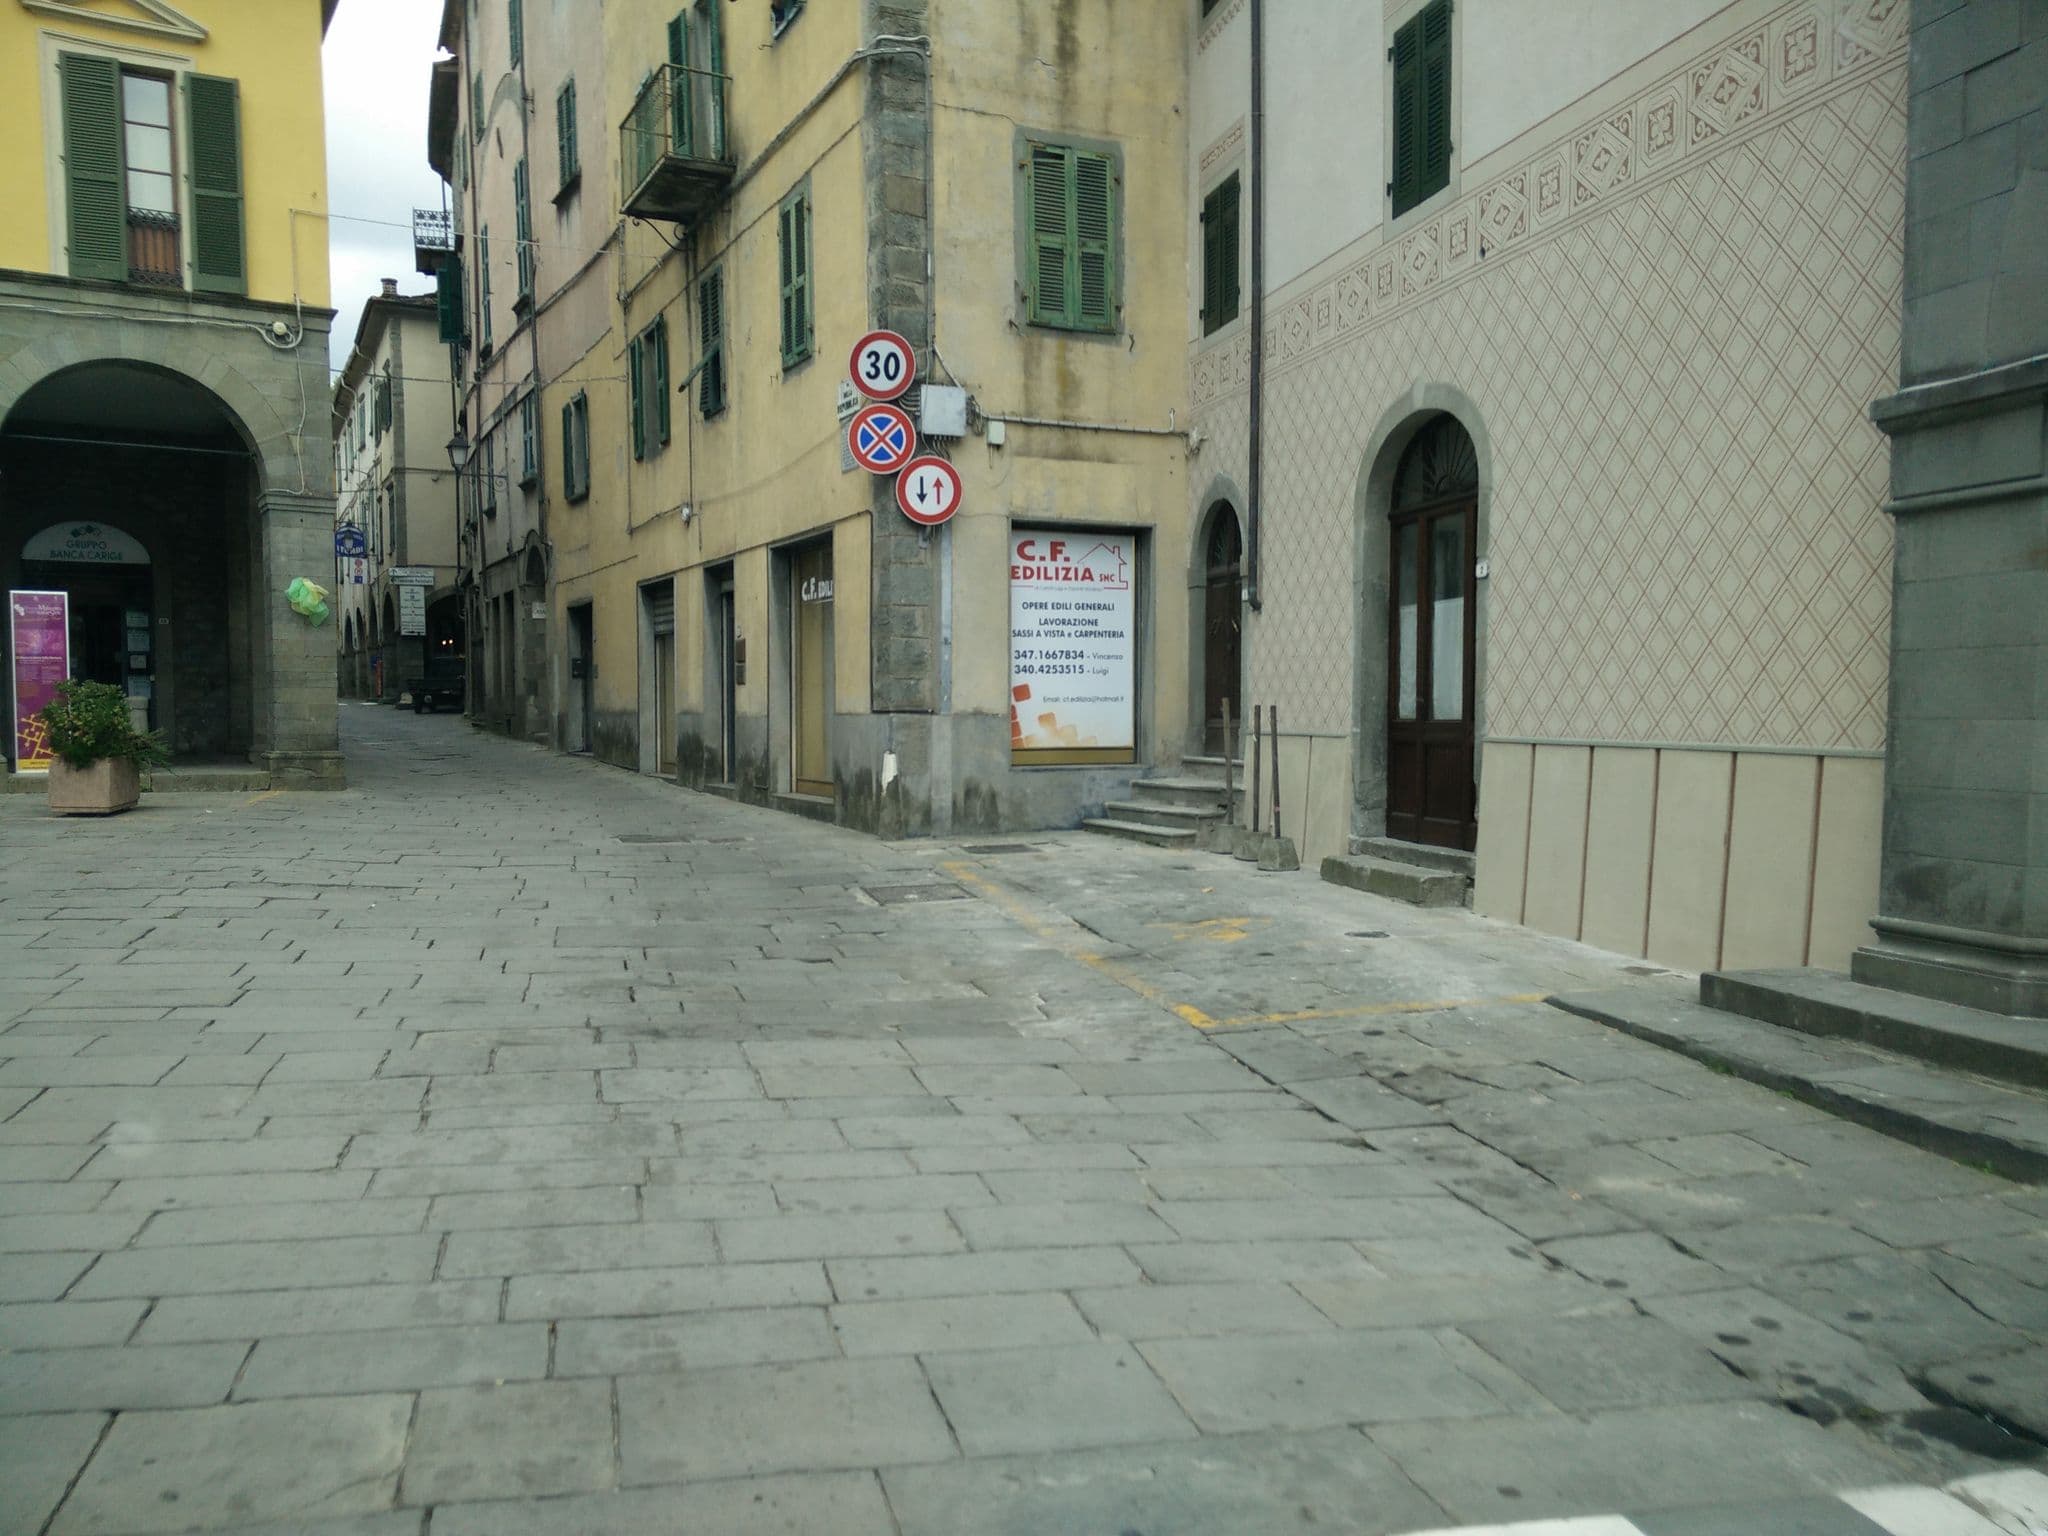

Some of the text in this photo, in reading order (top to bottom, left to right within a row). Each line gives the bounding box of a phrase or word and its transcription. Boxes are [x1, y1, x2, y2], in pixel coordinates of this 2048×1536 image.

[865, 350, 901, 381] 30
[66, 540, 107, 550] GRUPPO
[50, 550, 123, 560] BANCA CARIGE
[1016, 540, 1071, 562] C.F.
[1010, 565, 1115, 582] EDILIZIA SNC
[801, 577, 817, 601] C.F.
[1021, 602, 1115, 611] OPERE EDILI GENERALI
[1038, 618, 1099, 626] LAVORAZIONE
[1012, 629, 1034, 638] SASSI
[1035, 630, 1042, 638] A
[1043, 630, 1065, 638] VISTA
[1074, 630, 1124, 638] CARPENTERIA
[1014, 650, 1084, 660] 347.1667834
[1014, 664, 1084, 674] 340.4253515
[1092, 667, 1109, 675] Luigi
